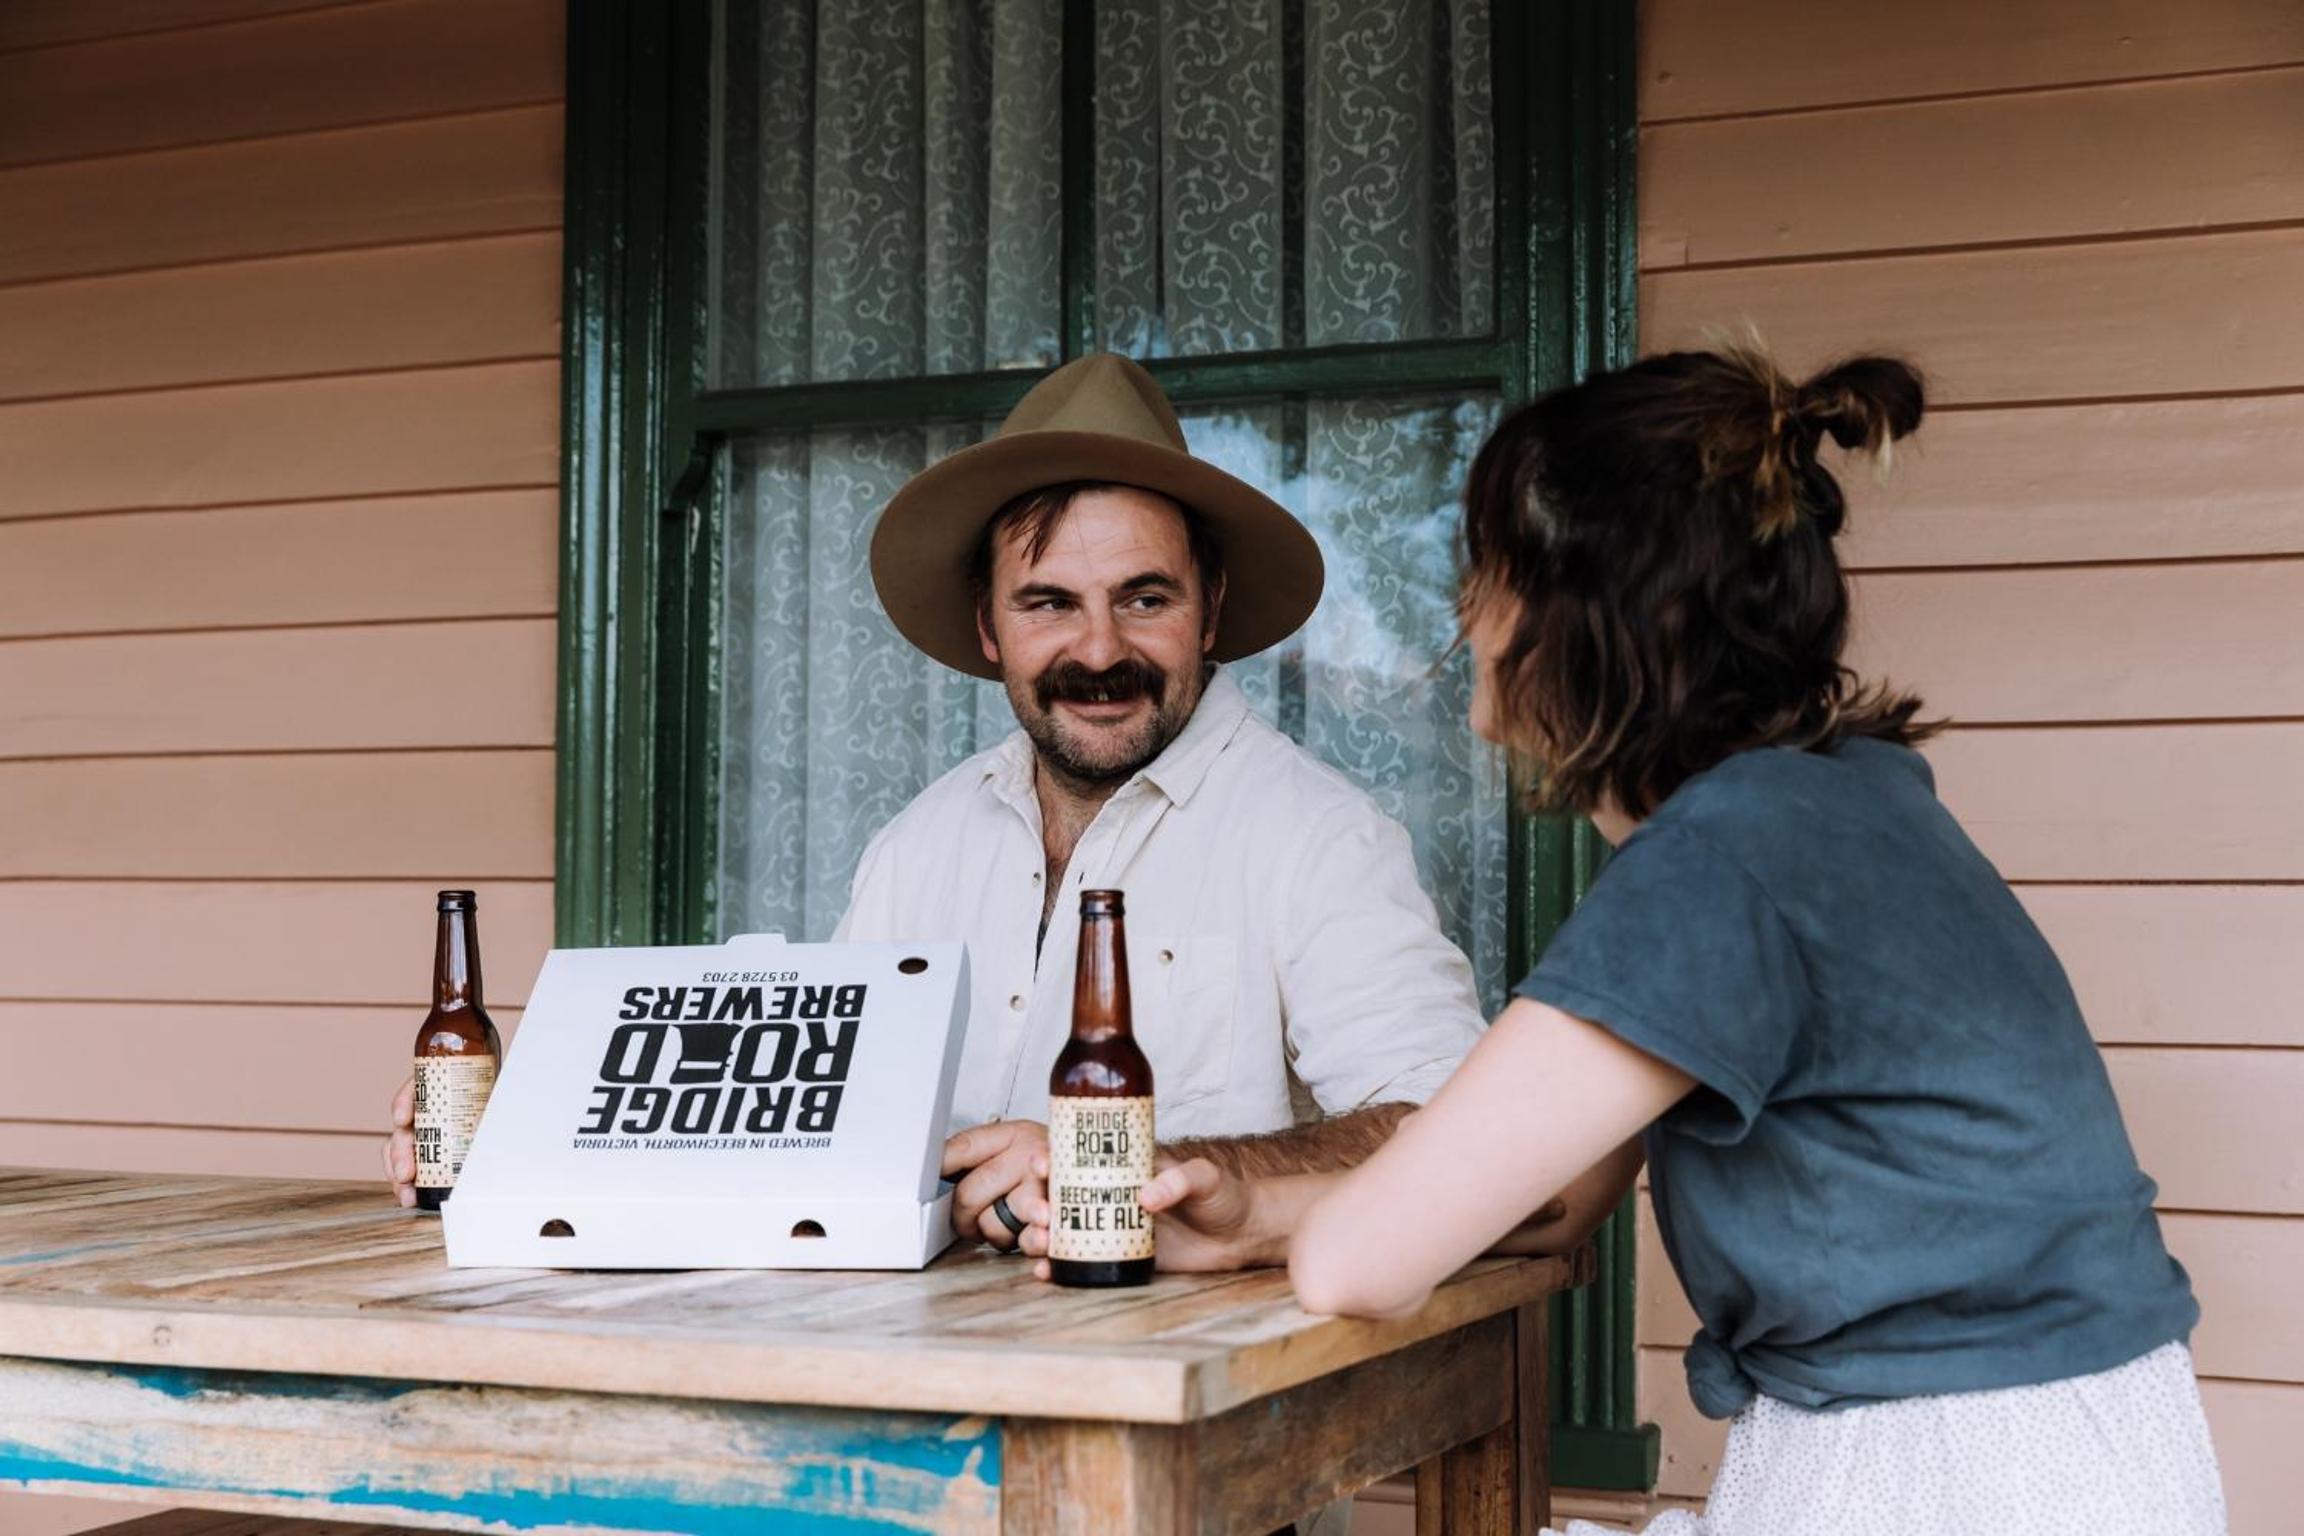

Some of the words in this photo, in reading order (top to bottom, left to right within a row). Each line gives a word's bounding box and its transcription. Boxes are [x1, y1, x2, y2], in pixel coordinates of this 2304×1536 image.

[702, 972, 738, 982] 2703
[743, 971, 777, 982] 5728
[780, 971, 798, 982] 03
[619, 984, 868, 1021] BREWERS
[577, 1084, 845, 1134] BRIDGE
[1076, 1111, 1129, 1130] BRIDGE
[573, 1138, 640, 1149] VICTORIA
[643, 1138, 746, 1149] BEECHWORTH,
[749, 1138, 765, 1149] IN
[770, 1138, 831, 1148] BREWED
[419, 1144, 441, 1163] ALE
[1076, 1155, 1129, 1168] BREWERS
[1060, 1185, 1142, 1204] BEECHWORT
[1114, 1206, 1144, 1230] ALE
